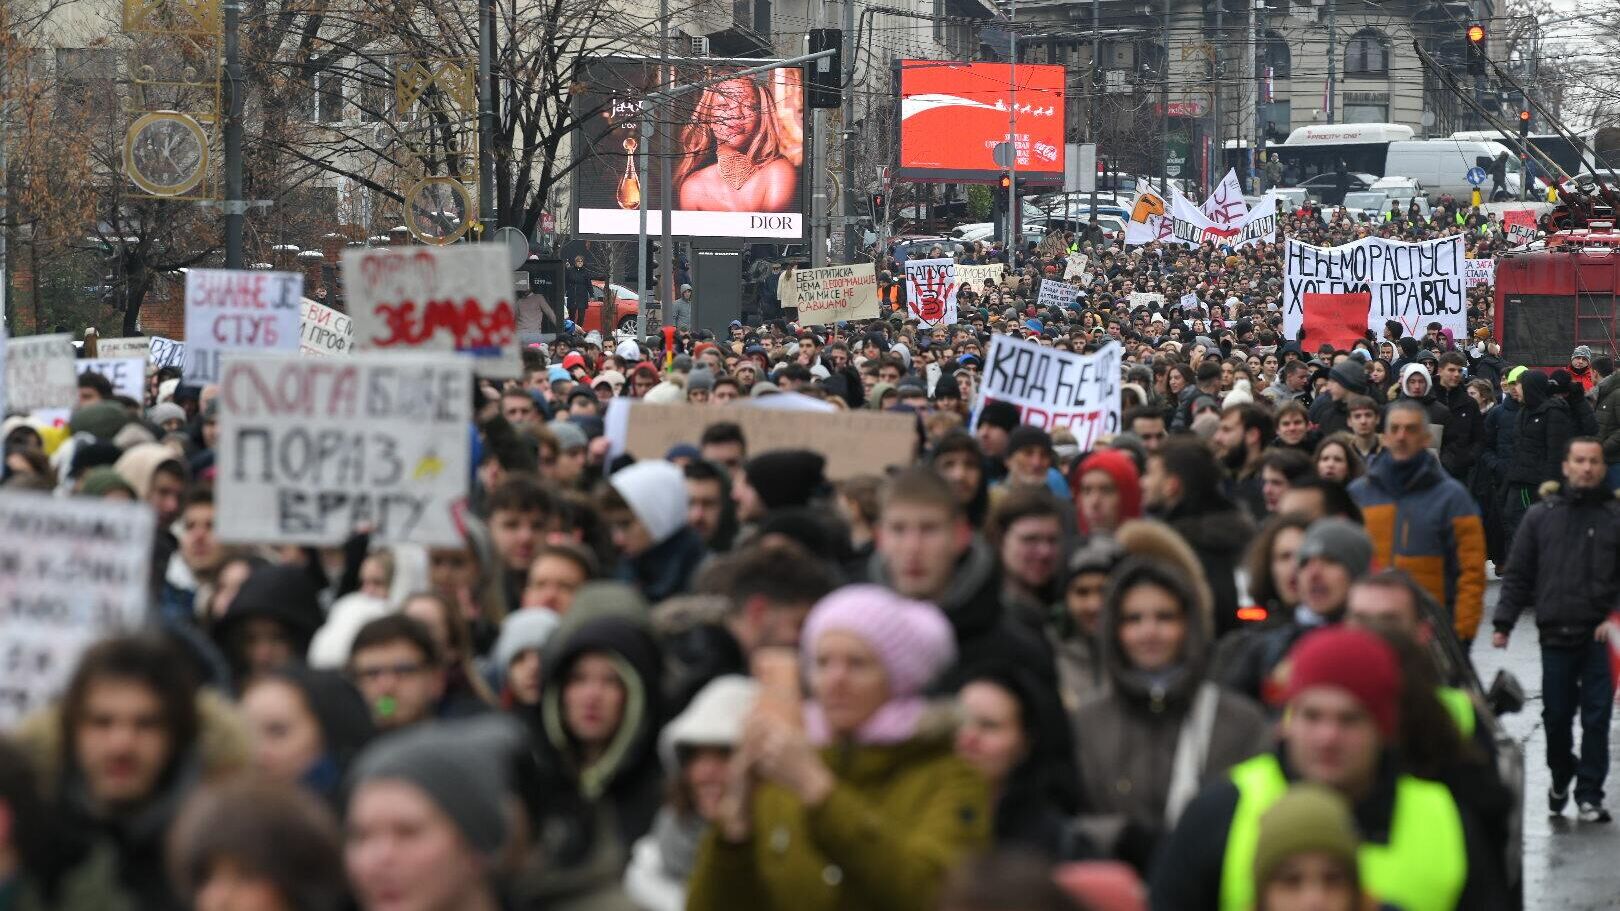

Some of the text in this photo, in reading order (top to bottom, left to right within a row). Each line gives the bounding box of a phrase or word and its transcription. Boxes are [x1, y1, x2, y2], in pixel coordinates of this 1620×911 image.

[750, 215, 793, 230] DIOR
[1510, 224, 1536, 240] DEJA
[1288, 238, 1460, 281] НЕЋЕМО РАСПУСТ
[796, 268, 853, 282] БЕЗ ПРИТИСКА
[796, 275, 876, 292] НЕМА ДЕФОРМАЦИЈЕ
[798, 299, 847, 312] САВИЈАМО
[817, 290, 829, 300] МИ
[830, 289, 840, 299] СЕ
[843, 288, 854, 297] НЕ
[1380, 279, 1462, 316] ПРАВДУ
[212, 313, 279, 346] СТУБ
[988, 342, 1050, 403] КАД
[1053, 359, 1093, 406] ЋЕ
[222, 360, 358, 417] СЛОГА
[231, 426, 403, 487] ПОРАЗ
